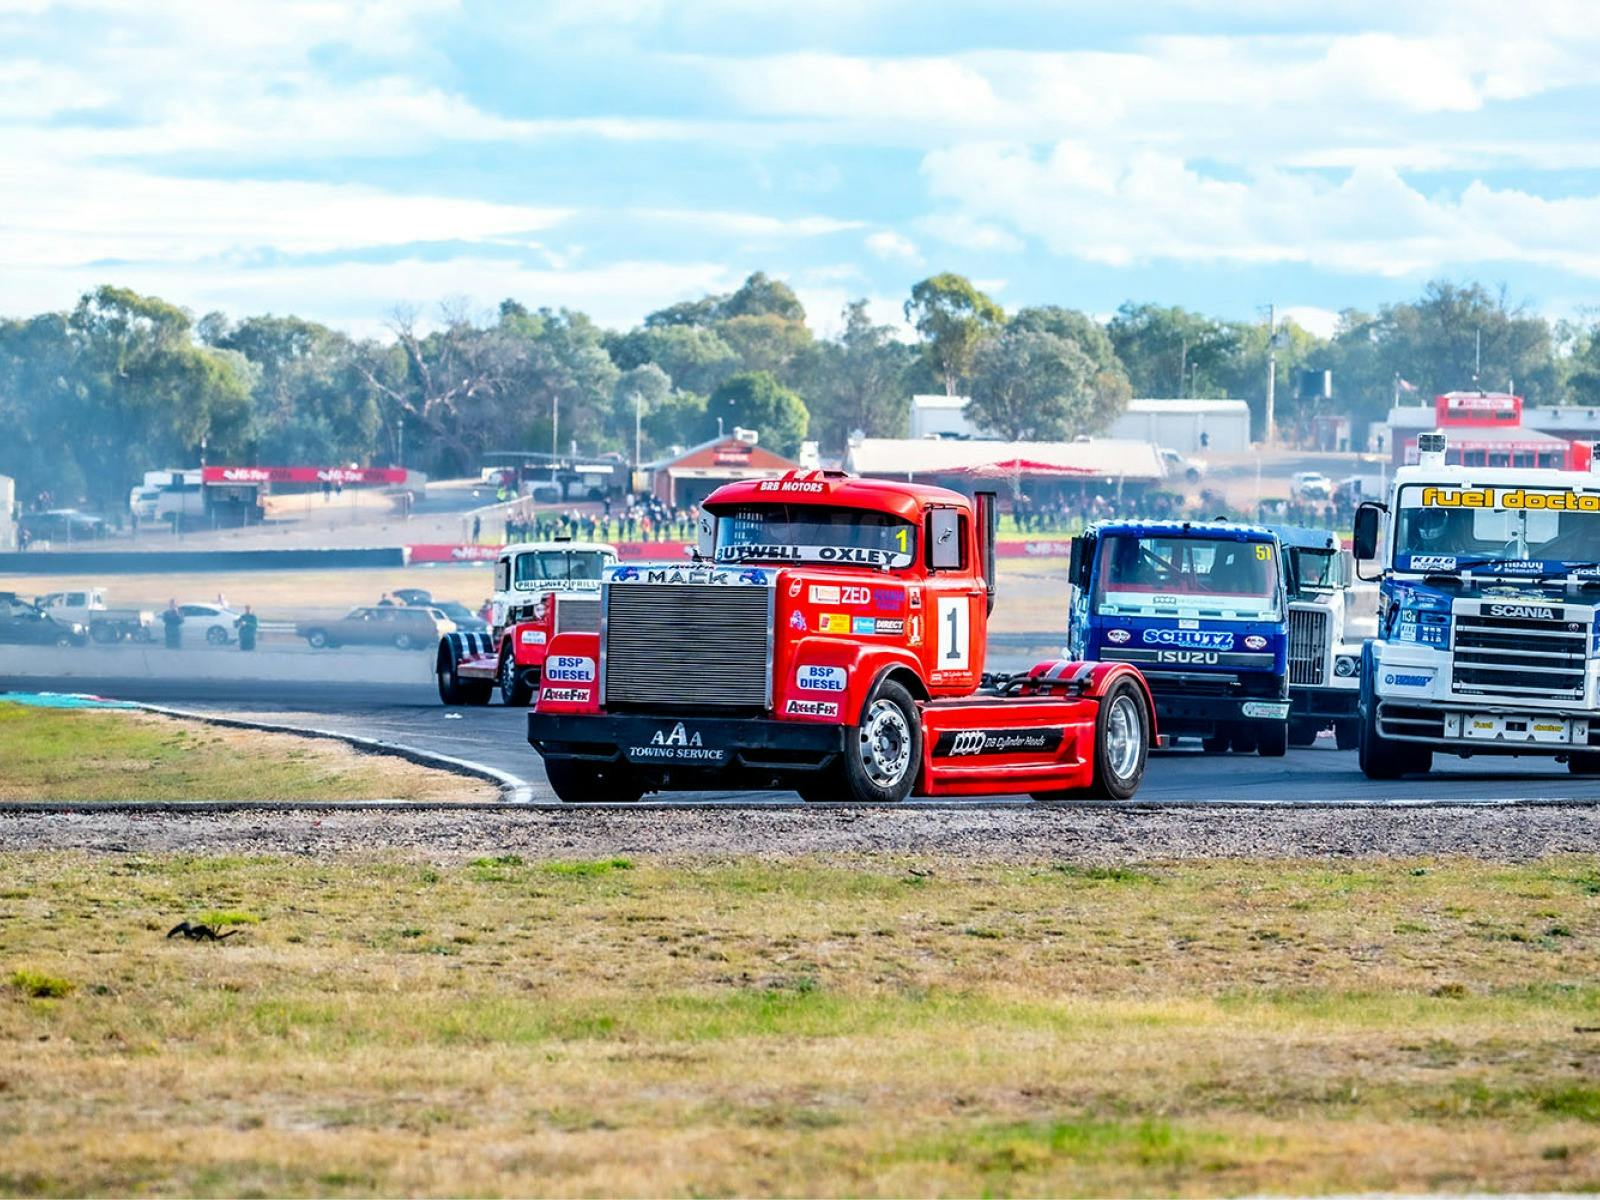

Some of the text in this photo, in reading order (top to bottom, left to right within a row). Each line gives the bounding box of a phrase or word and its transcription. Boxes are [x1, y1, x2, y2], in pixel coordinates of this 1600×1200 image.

[760, 481, 824, 493] BRB MOTORS
[1423, 487, 1600, 510] fuel docto
[895, 529, 908, 553] 1
[818, 547, 897, 565] OXLEY
[1255, 545, 1271, 560] 51
[648, 570, 729, 585] MACK
[841, 586, 871, 604] ZED
[1490, 604, 1554, 619] SCANIA
[876, 620, 904, 630] DIRECT
[946, 607, 960, 659] 1
[1143, 629, 1233, 646] SCHUTZ
[558, 657, 583, 668] BSP
[1157, 651, 1218, 665] ISUZU
[549, 669, 592, 681] DIESEL
[809, 666, 834, 677] BSP
[800, 678, 842, 690] DIESEL
[996, 736, 1025, 750] Cylinder
[1024, 735, 1046, 747] Heads
[630, 747, 724, 760] TOWING SERVICE
